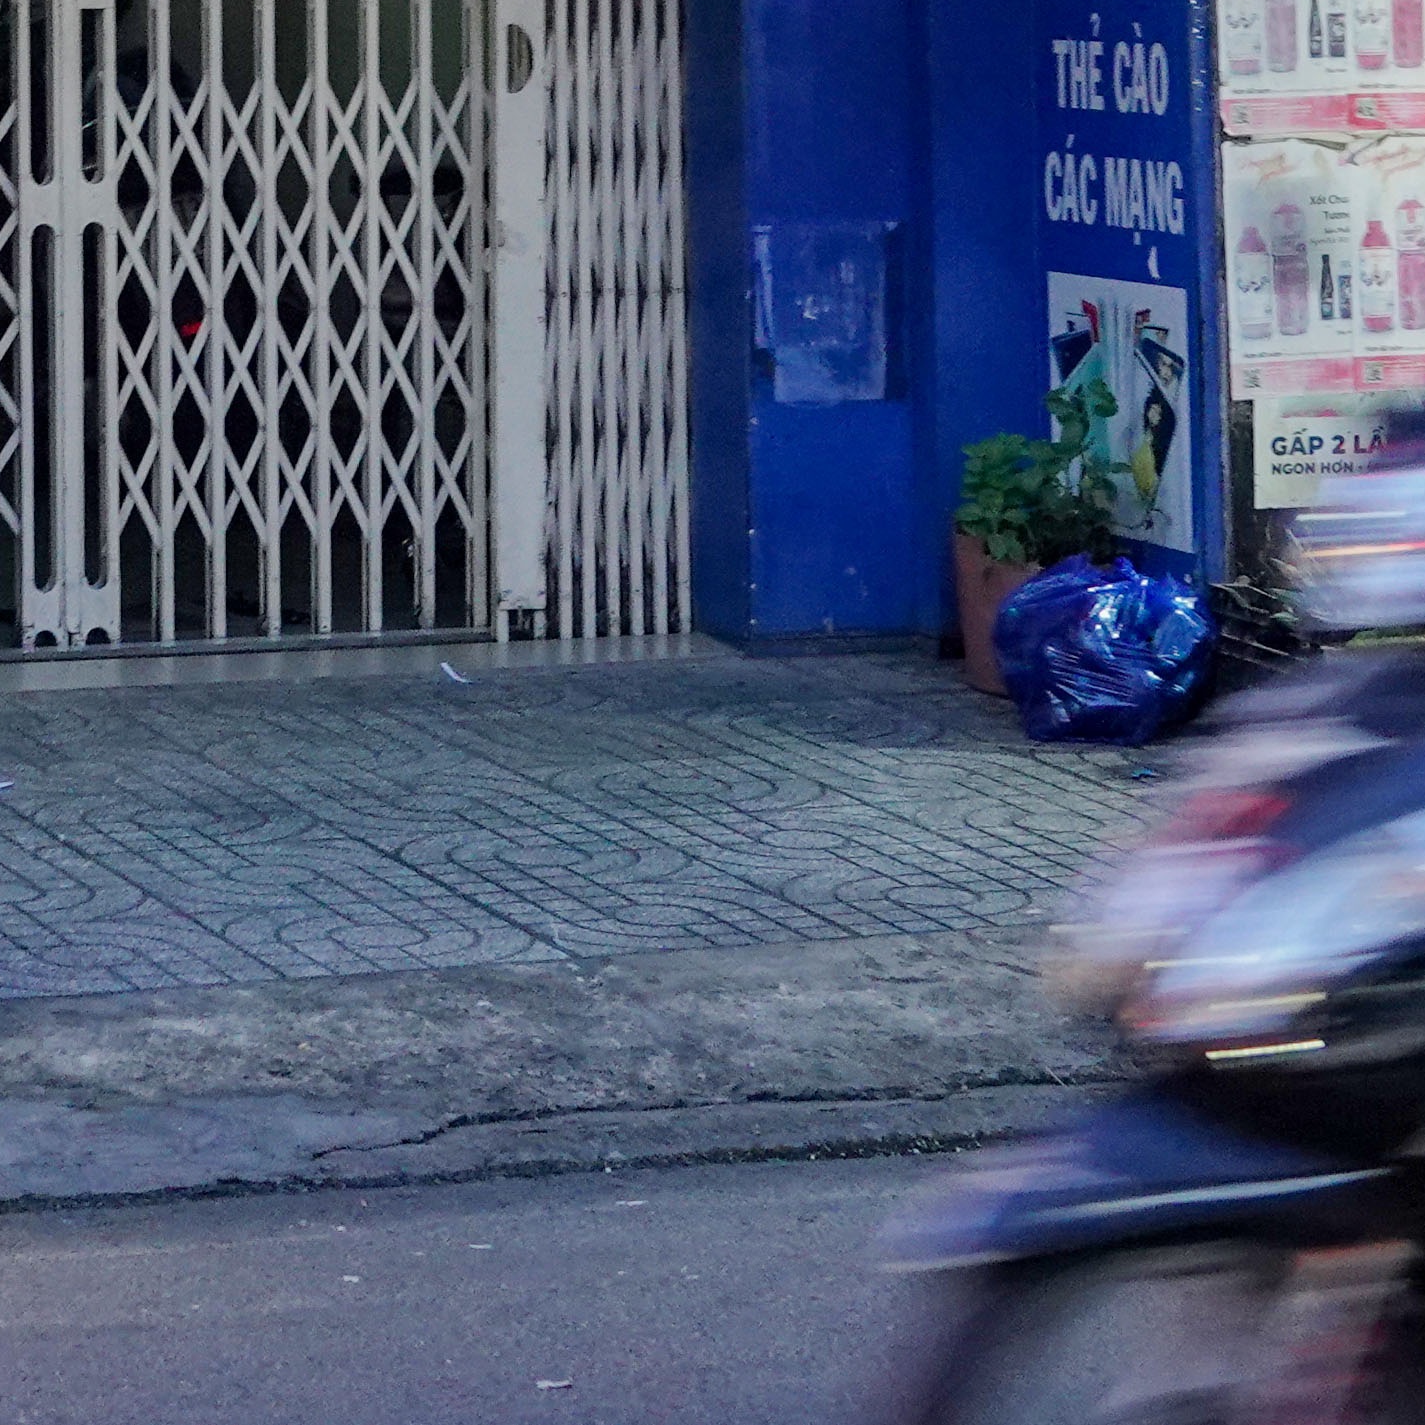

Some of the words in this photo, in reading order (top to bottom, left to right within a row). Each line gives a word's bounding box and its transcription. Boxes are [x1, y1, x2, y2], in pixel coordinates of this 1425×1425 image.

[1052, 12, 1105, 111] THẺ
[1113, 22, 1170, 116] CÀO
[1044, 134, 1099, 226] CÁC
[1103, 156, 1186, 245] MẠNG
[1271, 428, 1324, 456] GẤP
[1331, 434, 1346, 455] 2
[1353, 426, 1388, 455] LẦ
[1271, 461, 1316, 475] NGON
[1321, 459, 1354, 474] HƠN
